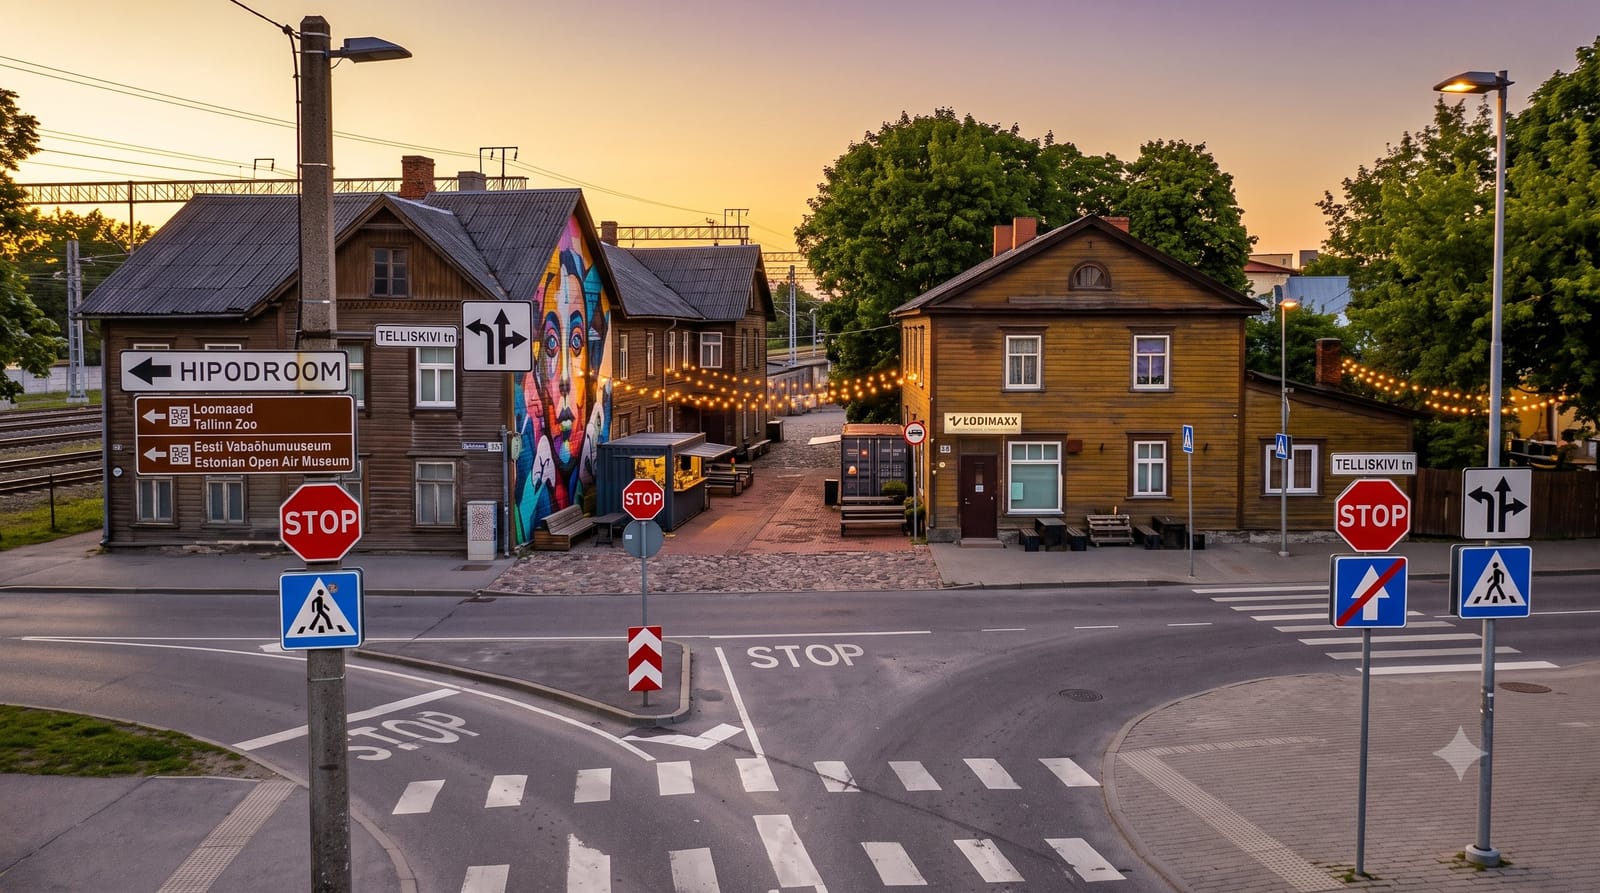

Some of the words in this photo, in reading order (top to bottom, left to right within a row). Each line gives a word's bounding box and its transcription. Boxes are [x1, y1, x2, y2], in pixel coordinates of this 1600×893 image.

[378, 330, 441, 342] TELLISKIVI
[444, 332, 455, 343] tn
[180, 361, 341, 381] HIPODROOM
[193, 402, 254, 414] Loomaaed
[193, 418, 232, 430] Tallinn
[235, 418, 258, 430] Zoo
[194, 441, 223, 452] Eesti
[226, 440, 332, 453] Vabaõhumuuseum
[195, 456, 246, 468] Estonian
[248, 456, 279, 470] Open
[282, 456, 299, 468] Air
[302, 455, 350, 467] Museum
[1335, 458, 1399, 470] TELLISKIVI
[1402, 459, 1413, 470] tn
[625, 492, 662, 506] STOP
[284, 509, 357, 536] STOP
[1339, 504, 1407, 528] STOP
[746, 643, 864, 669] STOP
